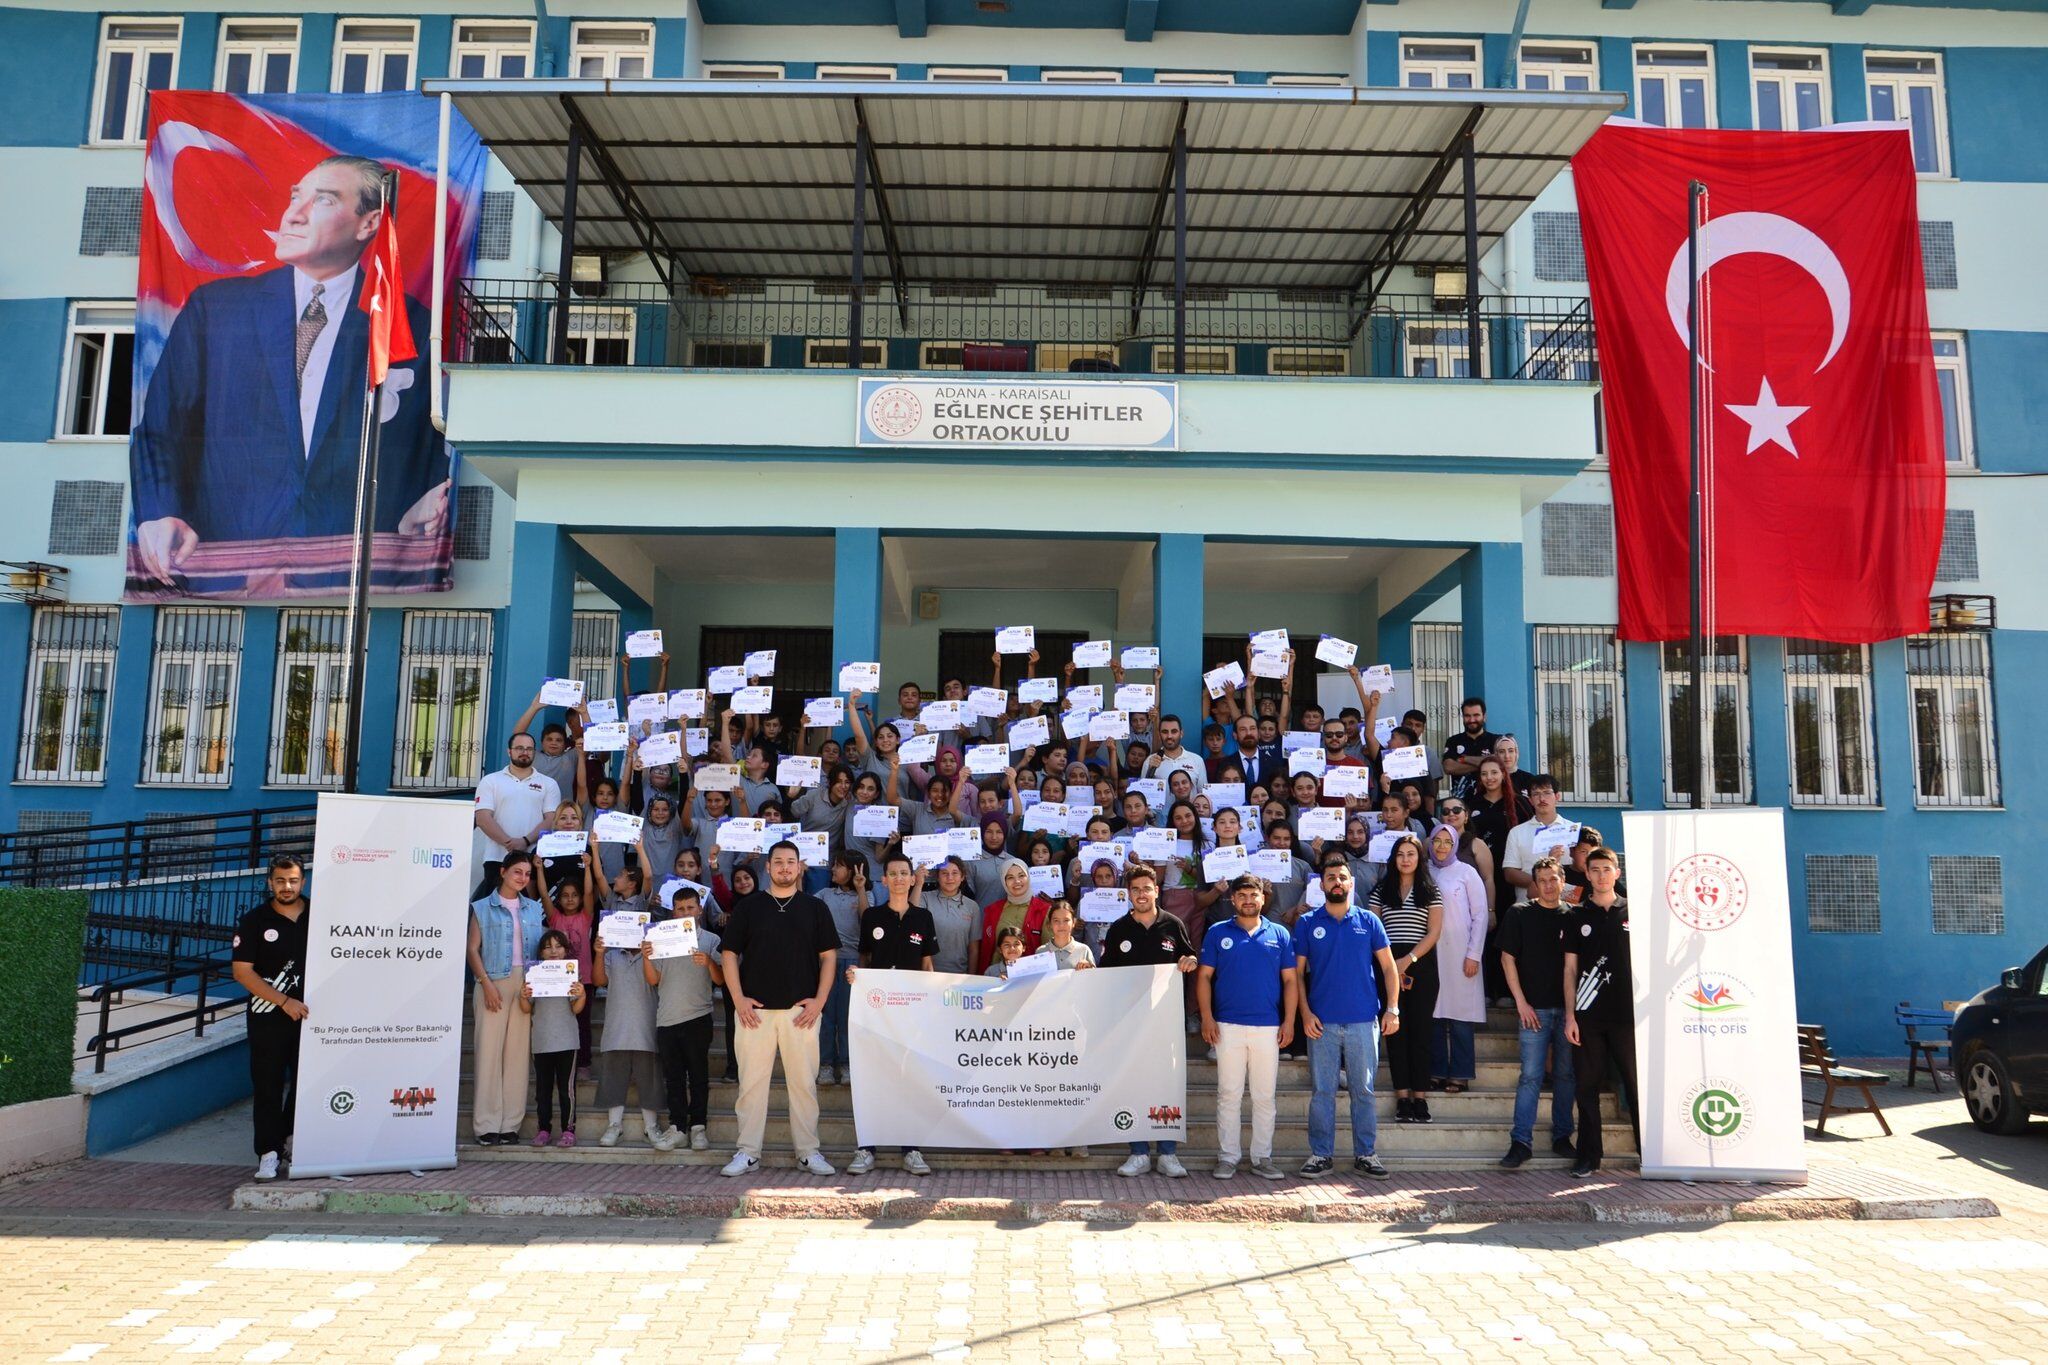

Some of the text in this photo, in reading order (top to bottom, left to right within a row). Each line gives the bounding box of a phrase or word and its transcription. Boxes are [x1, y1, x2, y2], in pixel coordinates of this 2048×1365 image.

[934, 387, 987, 399] ADANA
[999, 386, 1071, 400] KARAİSALI
[933, 400, 1034, 420] EĞLENCE
[1039, 403, 1143, 424] ŞEHİTLER
[932, 424, 1071, 442] ORTAOKULU
[398, 923, 442, 938] İzinde
[330, 946, 443, 961] Gelecek Köyde
[328, 1026, 349, 1036] Proje
[351, 1025, 381, 1035] Gençlik
[383, 1025, 393, 1033] Ve
[395, 1025, 414, 1035] Spor
[416, 1024, 452, 1034] Bakanlığı
[1028, 1025, 1076, 1041] İzinde
[1683, 1023, 1747, 1037] GENÇ OFİS
[321, 1037, 363, 1045] Tarafından
[957, 1052, 1079, 1069] Gelecek Köyde
[955, 1084, 980, 1096] Proje
[982, 1084, 1018, 1095] Gençlik
[1019, 1083, 1032, 1093] Ve
[1034, 1084, 1057, 1095] Spor
[1059, 1083, 1102, 1094] Bakanlığı
[947, 1099, 996, 1109] Tarafından
